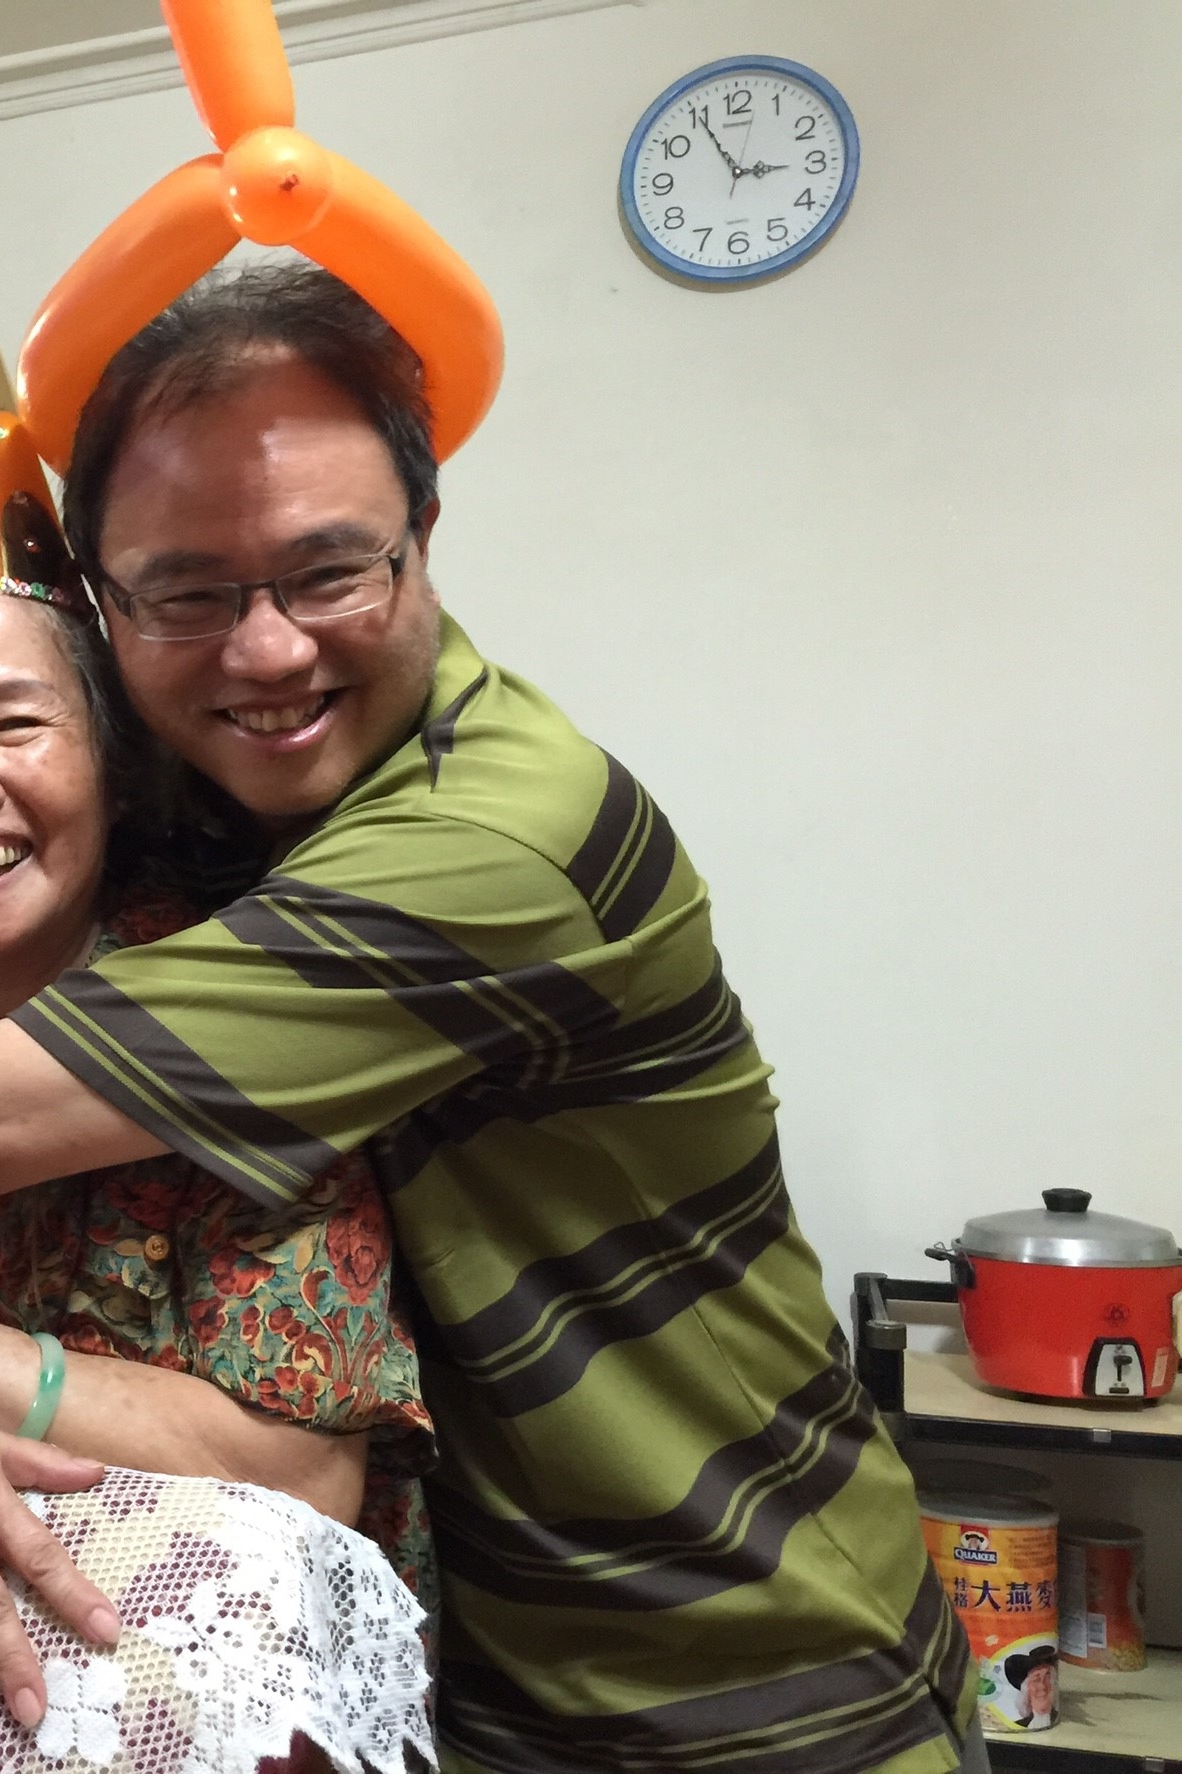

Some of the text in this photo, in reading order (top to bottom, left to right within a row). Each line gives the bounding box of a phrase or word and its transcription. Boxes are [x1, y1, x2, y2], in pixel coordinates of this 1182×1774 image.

[722, 89, 753, 115] 12
[771, 93, 780, 116] 1
[688, 104, 709, 129] 11
[794, 115, 816, 141] 2
[660, 134, 691, 160] 10
[804, 150, 827, 175] 3
[651, 172, 674, 196] 9
[793, 187, 816, 211] 4
[663, 206, 685, 230] 8
[766, 217, 788, 242] 5
[692, 227, 714, 252] 7
[727, 230, 750, 255] 6
[954, 1548, 996, 1562] QUAKER
[970, 1580, 1058, 1612] 大燕麥
